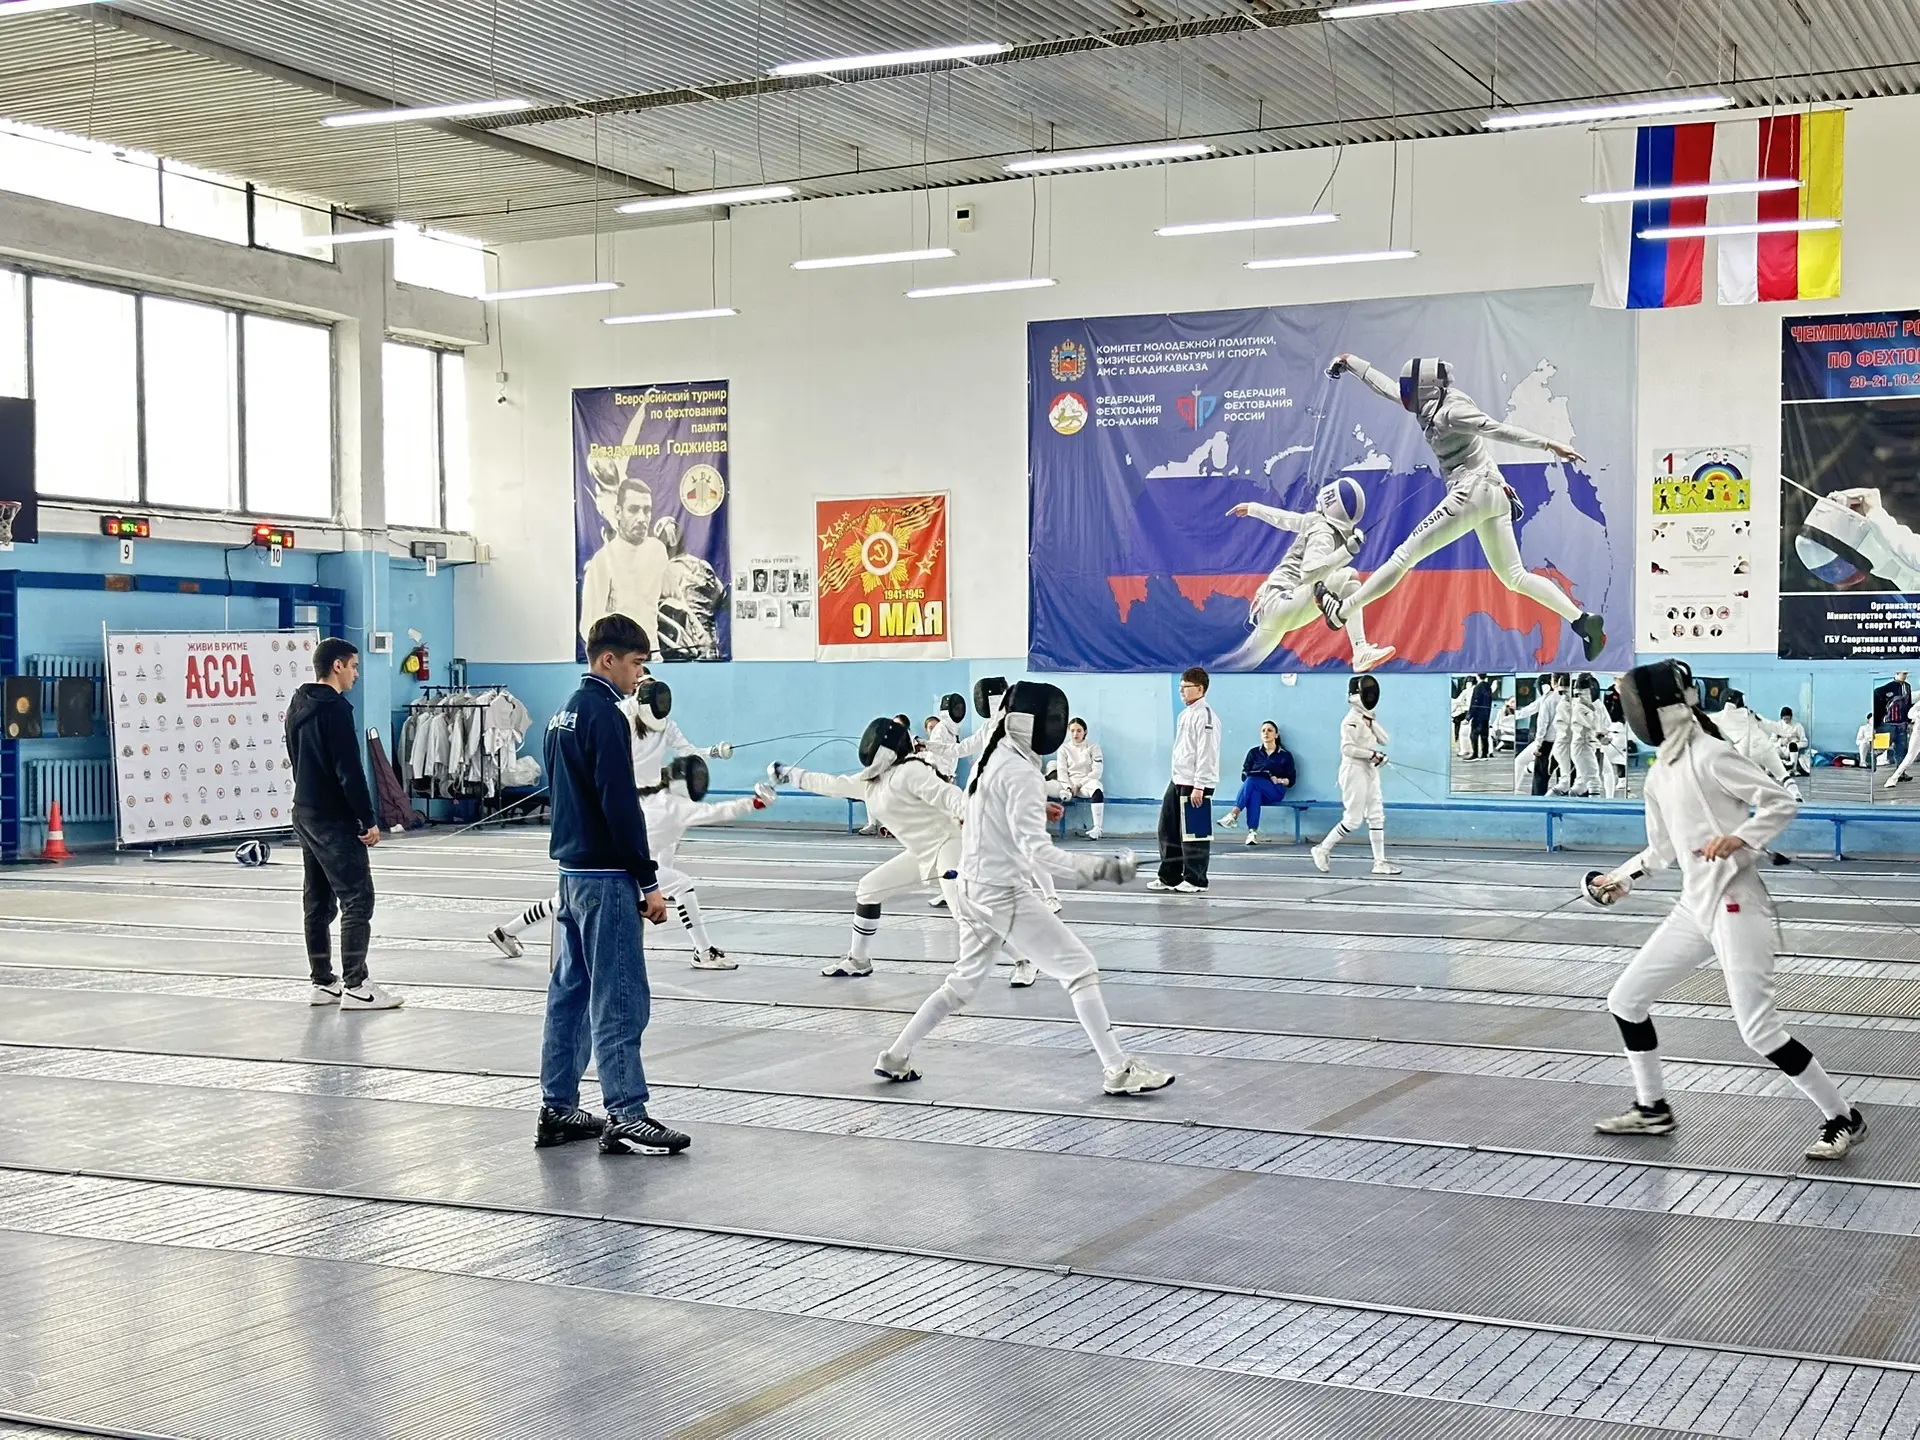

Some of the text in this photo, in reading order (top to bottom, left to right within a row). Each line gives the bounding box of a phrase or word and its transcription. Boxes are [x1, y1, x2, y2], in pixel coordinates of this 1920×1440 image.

[1791, 321, 1898, 342] ЧЕМПИОНАТ
[1096, 335, 1277, 354] КОМИТЕТ МОЛОДЕЖНОЙ ПОЛИТИКИ,
[1096, 347, 1268, 365] ФИЗИЧЕСКОЙ КУЛЬТУРЫ И СПОРТА
[1827, 351, 1851, 369] ПО
[1096, 362, 1209, 377] АМС г. ВЛАДИКАВКАЗА
[692, 389, 727, 403] турнир
[1096, 394, 1156, 406] ФЕДЕРАЦИЯ
[1224, 387, 1287, 400] ФЕДЕРАЦИЯ
[1096, 405, 1162, 416] ФЕХТОВАНИЯ
[1224, 398, 1293, 411] ФЕХТОВАНИЯ
[651, 405, 727, 421] по фехтованию
[1224, 411, 1266, 422] РОССИИ
[691, 423, 727, 434] памяти
[1096, 416, 1159, 427] РСО-АЛАНИЯ
[590, 439, 727, 459] Владимира Годжиева
[1662, 452, 1673, 475] 1
[1654, 475, 1690, 485] ИЮЯ
[1323, 488, 1337, 509] FRA
[124, 544, 130, 559] 9
[272, 548, 281, 563] 10
[428, 559, 435, 573] 11
[884, 588, 925, 600] 1941-1945
[853, 600, 943, 638] 9 МАЯ
[1827, 612, 1883, 621] Министерство
[187, 641, 248, 651] ЖИВИ В РИТМЕ
[1824, 635, 1840, 643] ГБУ
[1842, 635, 1888, 644] Спортивная
[1852, 646, 1885, 654] резерва
[185, 654, 256, 699] АССА
